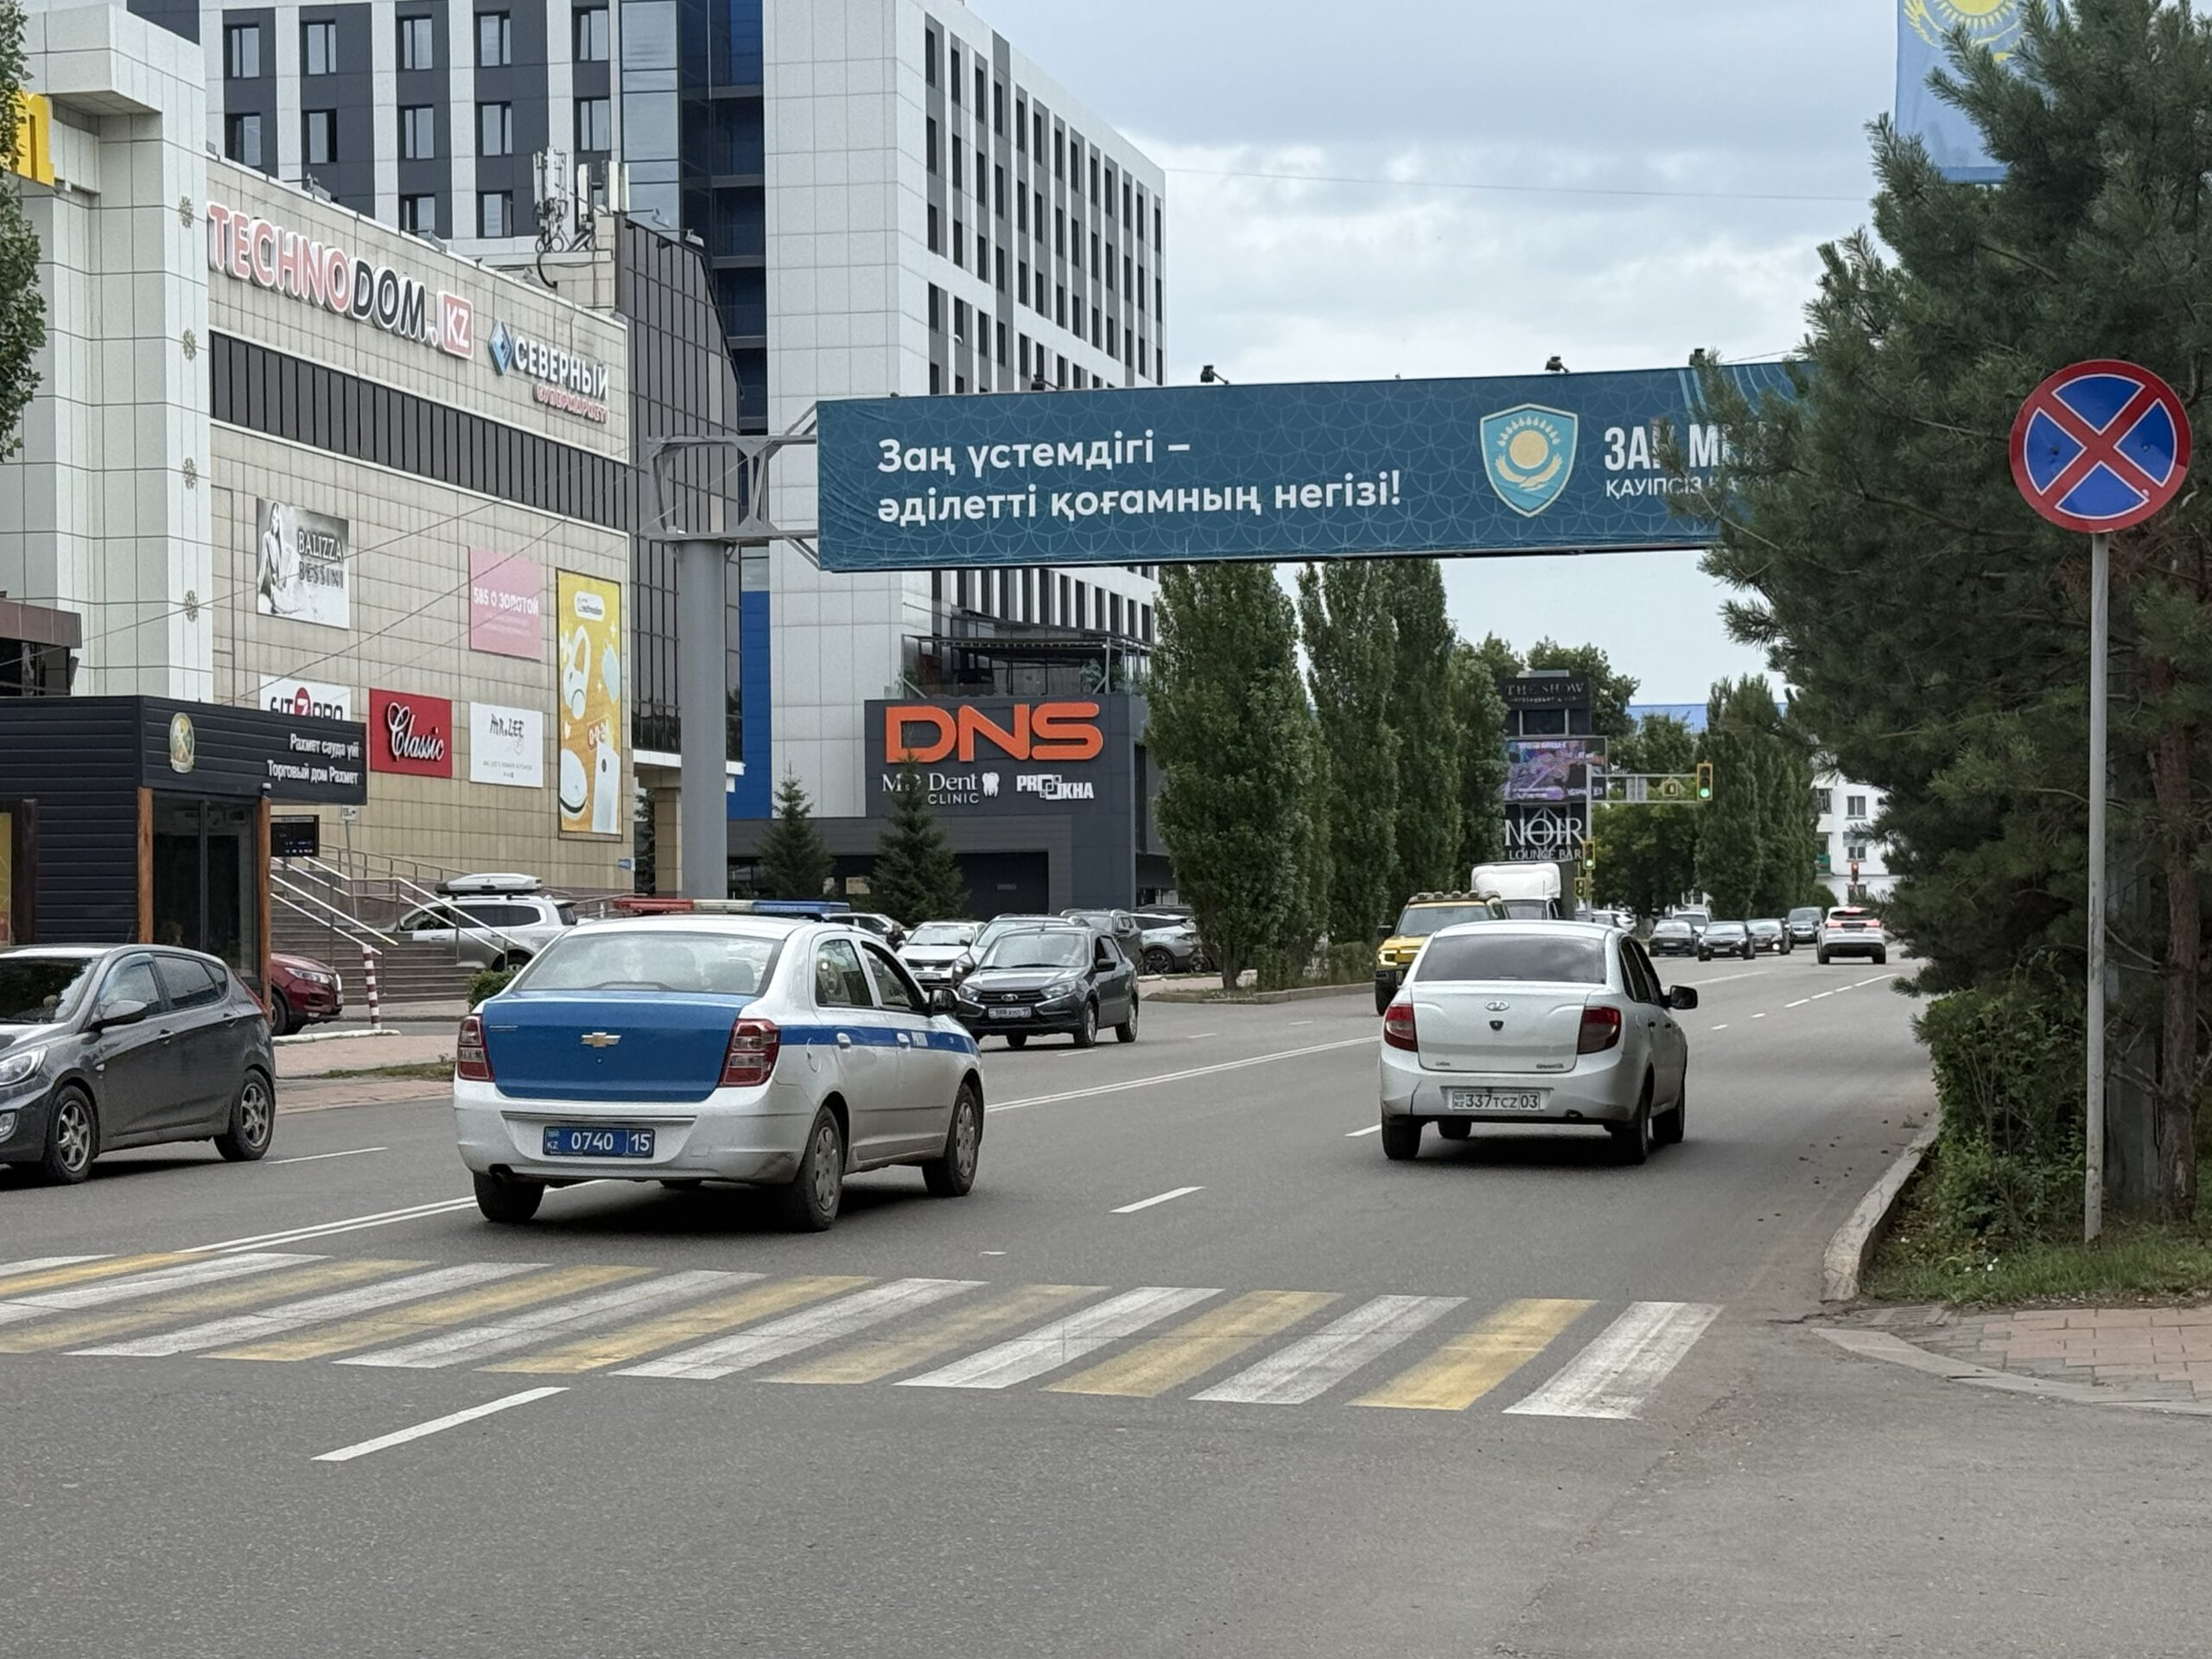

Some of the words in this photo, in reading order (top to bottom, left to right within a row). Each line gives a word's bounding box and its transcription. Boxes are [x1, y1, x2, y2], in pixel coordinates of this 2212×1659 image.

[514, 335, 609, 400] СЕВЕРНЫЙ
[878, 439, 955, 475] Заң
[968, 429, 1154, 478] үстемдігі
[878, 484, 1038, 526] әділетті
[1052, 484, 1262, 523] қоғамның
[1275, 470, 1402, 510] негізі!
[298, 530, 344, 563] BALIZZA
[298, 561, 344, 589] BESSINI
[474, 587, 489, 606] 585
[1541, 683, 1585, 694] SHOW
[388, 702, 444, 761] Classic
[886, 702, 1103, 763] DNS
[290, 733, 321, 753] Рахмет
[321, 741, 346, 759] сауда
[267, 760, 309, 781] Торговый
[310, 767, 327, 784] дом
[329, 766, 359, 785] Рахмет
[927, 793, 980, 804] CLINIC
[1504, 817, 1585, 846] NOIR
[1509, 849, 1555, 860] LOUNGE
[1559, 849, 1582, 860] BAR
[1520, 1095, 1538, 1108] 03
[571, 1132, 613, 1151] 0740
[631, 1134, 651, 1152] 15
